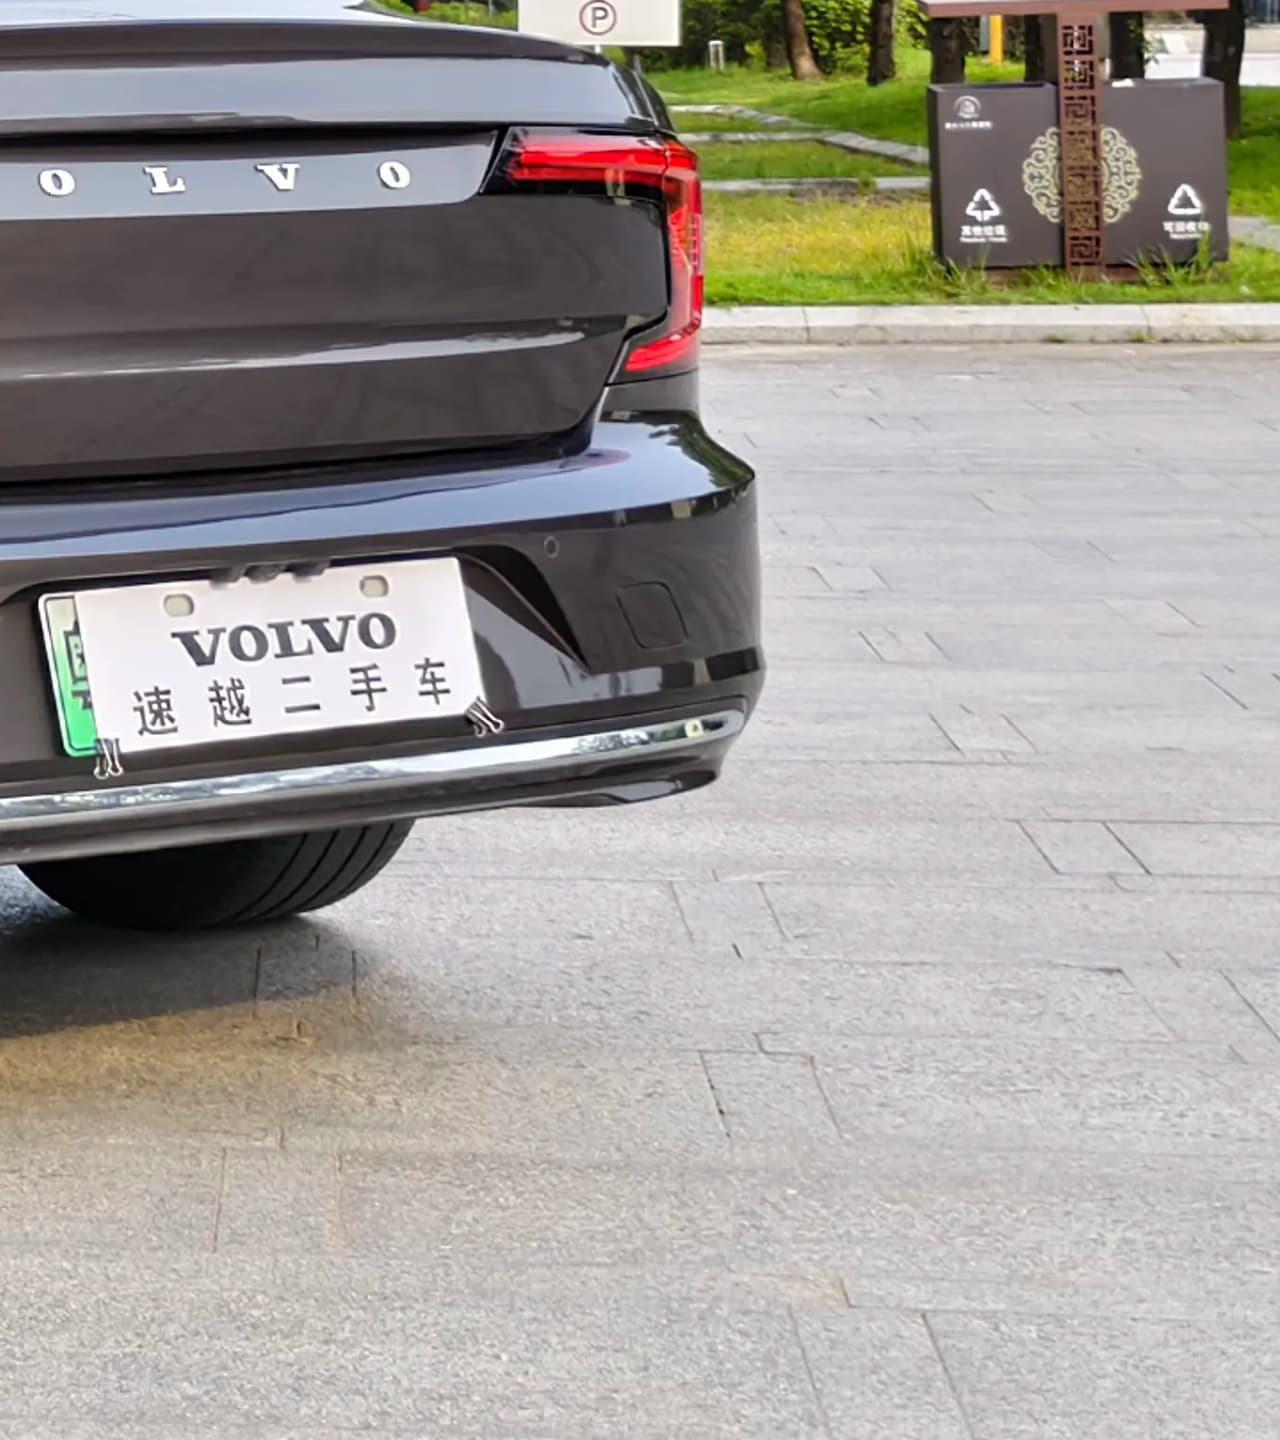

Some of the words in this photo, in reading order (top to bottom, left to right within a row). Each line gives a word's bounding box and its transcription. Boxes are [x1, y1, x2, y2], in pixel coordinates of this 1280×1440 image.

[171, 612, 397, 667] VOLVO
[133, 657, 451, 736] 速越二手车
